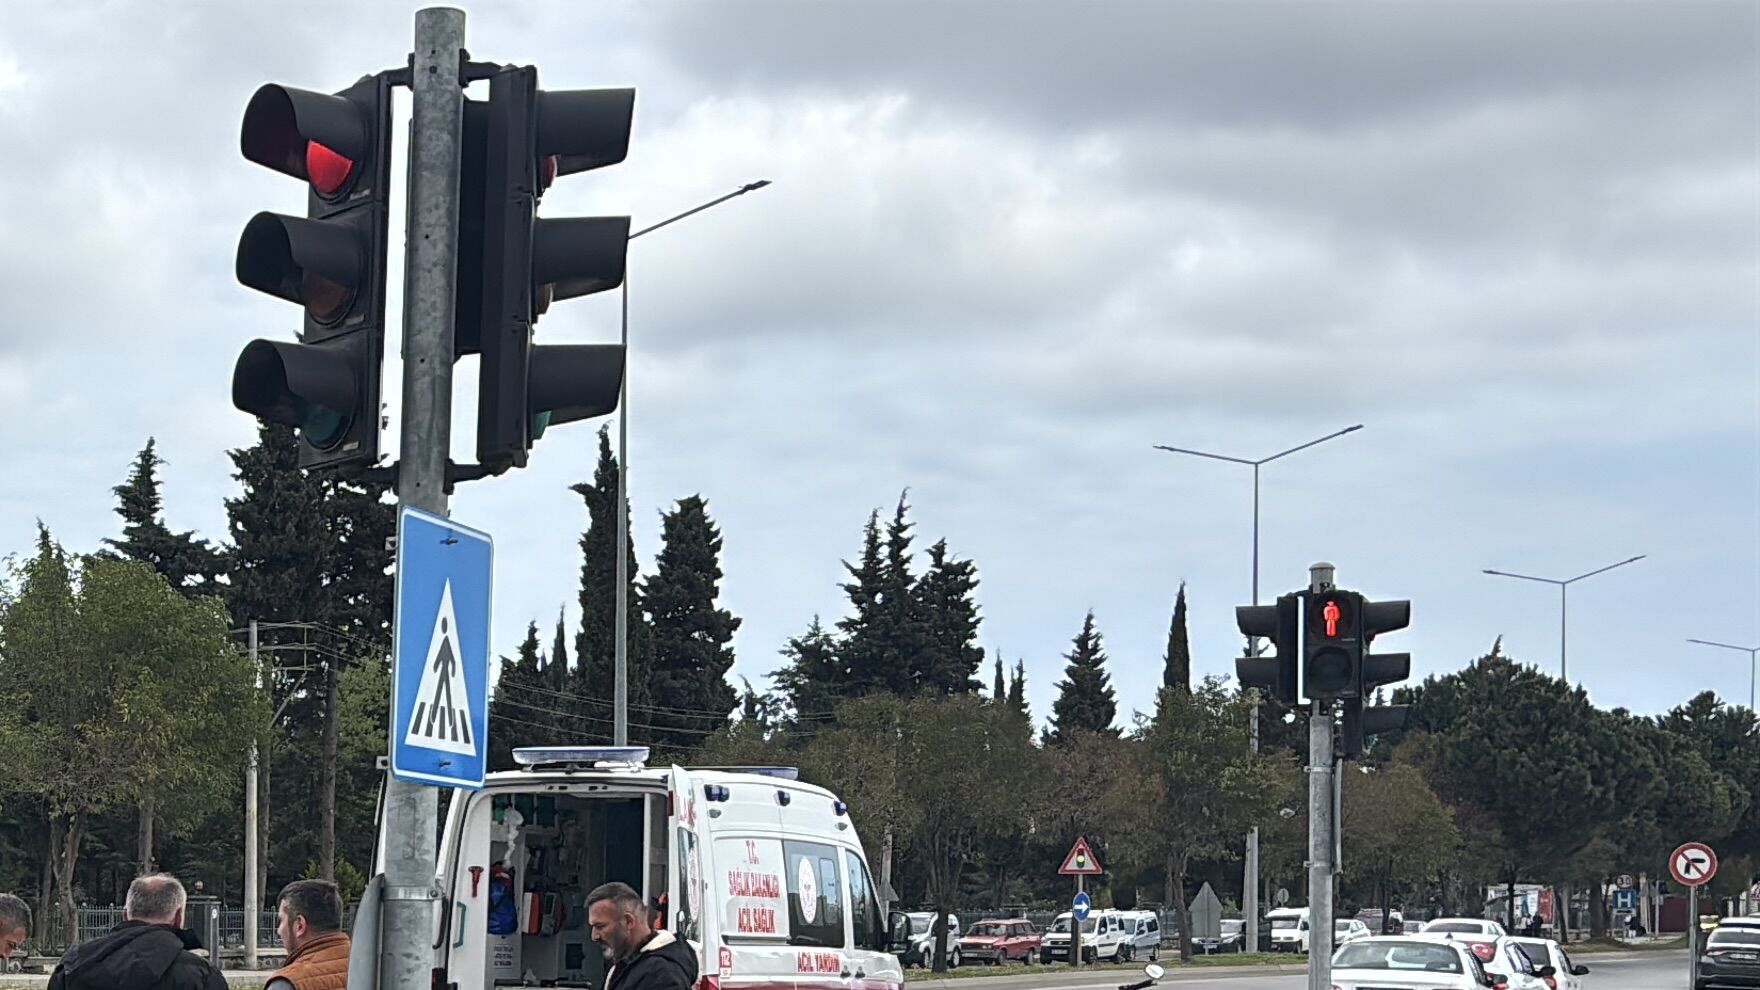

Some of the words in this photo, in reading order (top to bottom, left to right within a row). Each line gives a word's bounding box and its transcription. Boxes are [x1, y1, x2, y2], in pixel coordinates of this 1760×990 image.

[1617, 892, 1632, 908] H
[738, 903, 753, 933] ACİL
[753, 903, 776, 933] SAĞLIK
